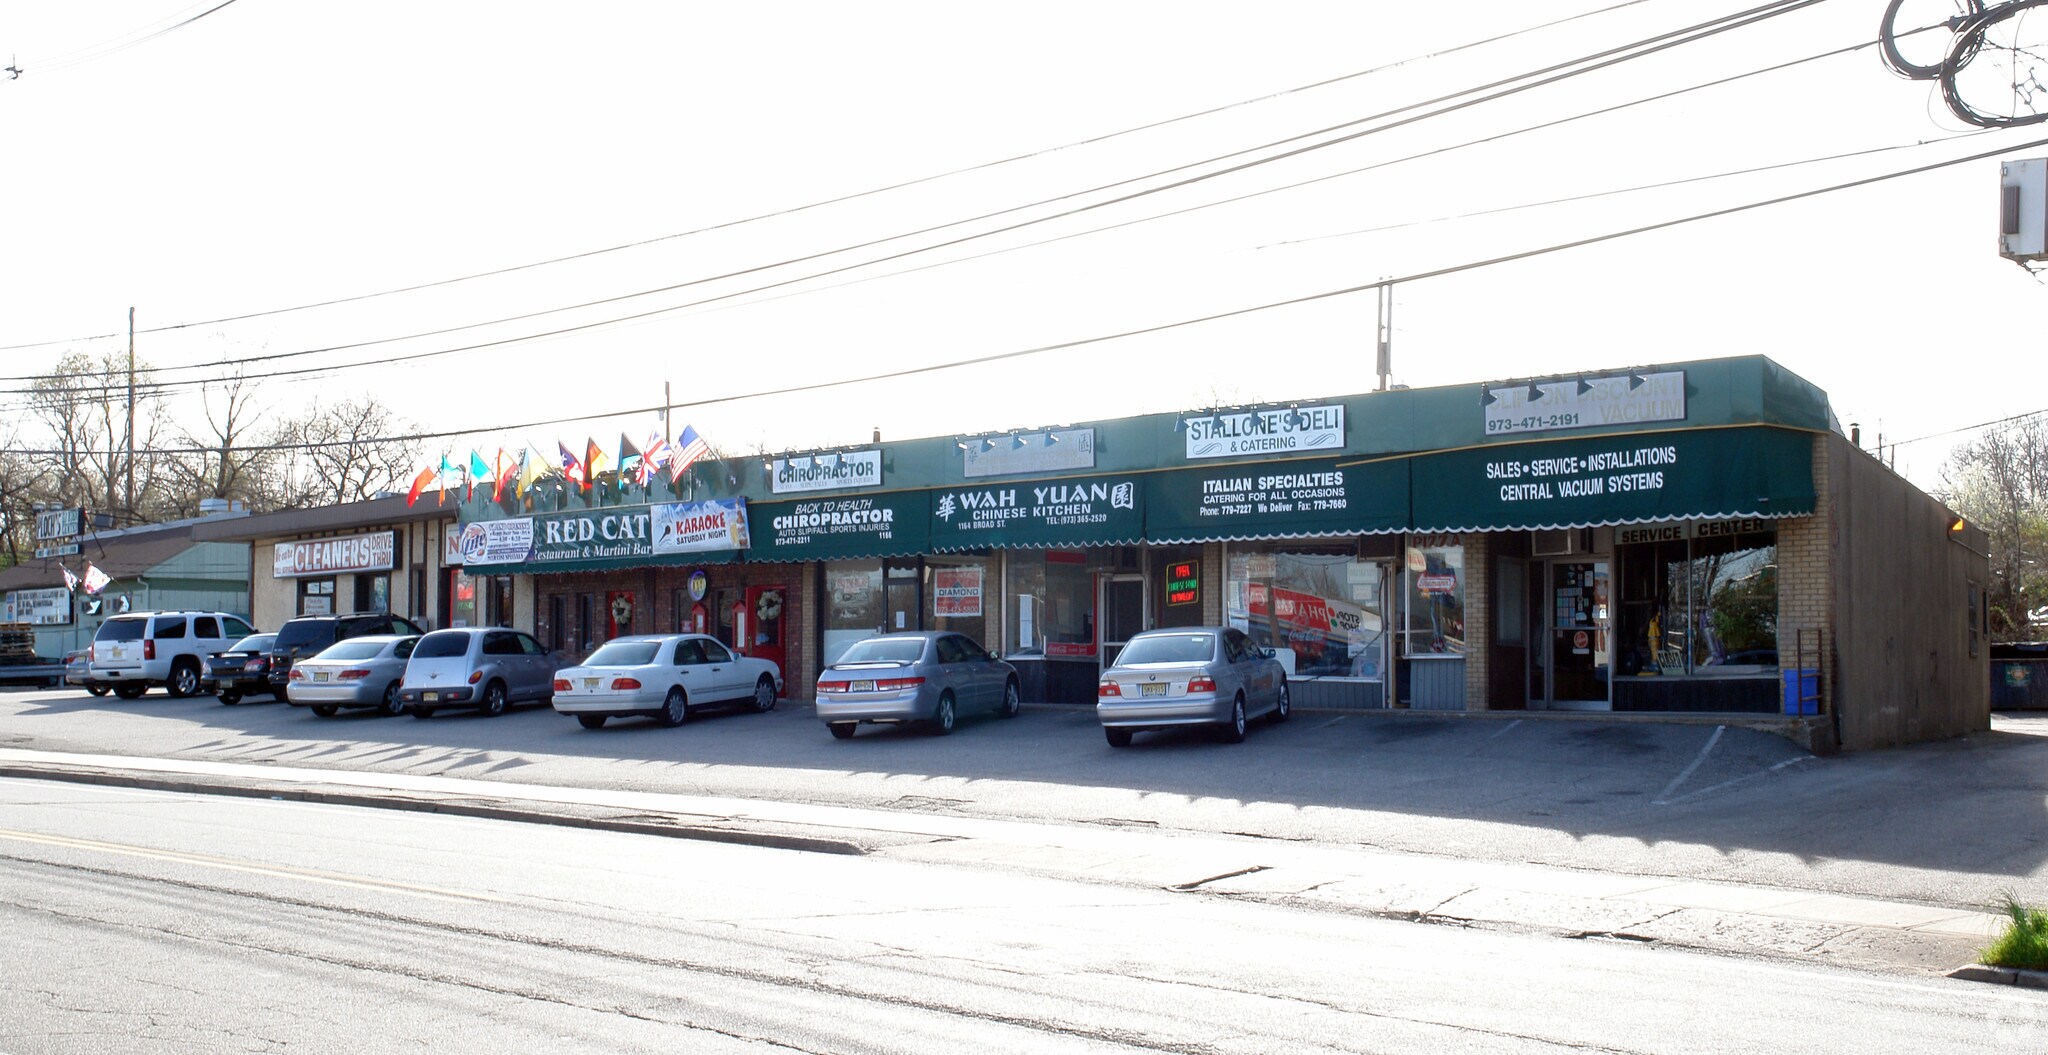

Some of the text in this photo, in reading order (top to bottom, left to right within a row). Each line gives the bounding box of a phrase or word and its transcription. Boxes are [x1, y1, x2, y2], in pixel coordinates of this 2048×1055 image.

[1600, 398, 1683, 424] VACUUM
[1191, 408, 1339, 440] STALLONE'S DELI
[1488, 413, 1579, 432] 973-471-2191
[1230, 437, 1296, 452] & CATERING
[1486, 446, 1676, 479] SALES SERVICE INSTALLATIONS
[779, 461, 874, 484] CHIROPRACTOR
[1203, 471, 1344, 493] ITALIAN SPECIALTIES
[1203, 488, 1345, 504] CATERING FOR ALL OCCASIONS
[1500, 472, 1664, 501] CENTRAL VACUUM SYSTEMS
[959, 483, 1108, 510] WAH YUAN
[795, 499, 873, 514] BACK TO HEALTH
[935, 492, 957, 522] 華
[973, 503, 1091, 520] CHINESE KITCHEN
[1200, 506, 1219, 516] Phone:
[1221, 504, 1252, 515] 779-7227
[1258, 503, 1268, 513] We
[1269, 502, 1293, 513] Deliver
[1297, 501, 1312, 511] Fax:
[546, 514, 649, 544] RED CAT
[676, 511, 726, 536] KARAOKE
[773, 509, 893, 530] CHIROPRACTOR
[973, 520, 994, 529] BROAD
[1046, 516, 1060, 525] TEL:
[1060, 515, 1077, 525] (973)
[676, 530, 727, 545] SATURDAY NIGHT
[779, 528, 796, 537] AUTO
[830, 524, 857, 534] SPORTS
[859, 522, 890, 532] INJURIES
[1622, 519, 1764, 543] SERVICE CENTER
[371, 534, 392, 550] DRIVE
[448, 536, 460, 555] N
[582, 545, 590, 557] &
[593, 543, 631, 557] Martini
[633, 542, 652, 555] Bar
[1412, 533, 1461, 547] PIZZA
[294, 538, 370, 571] CLEANERS
[373, 550, 392, 567] THRU
[938, 588, 979, 596] DIAMOND
[1658, 651, 1683, 669] CLOSED
